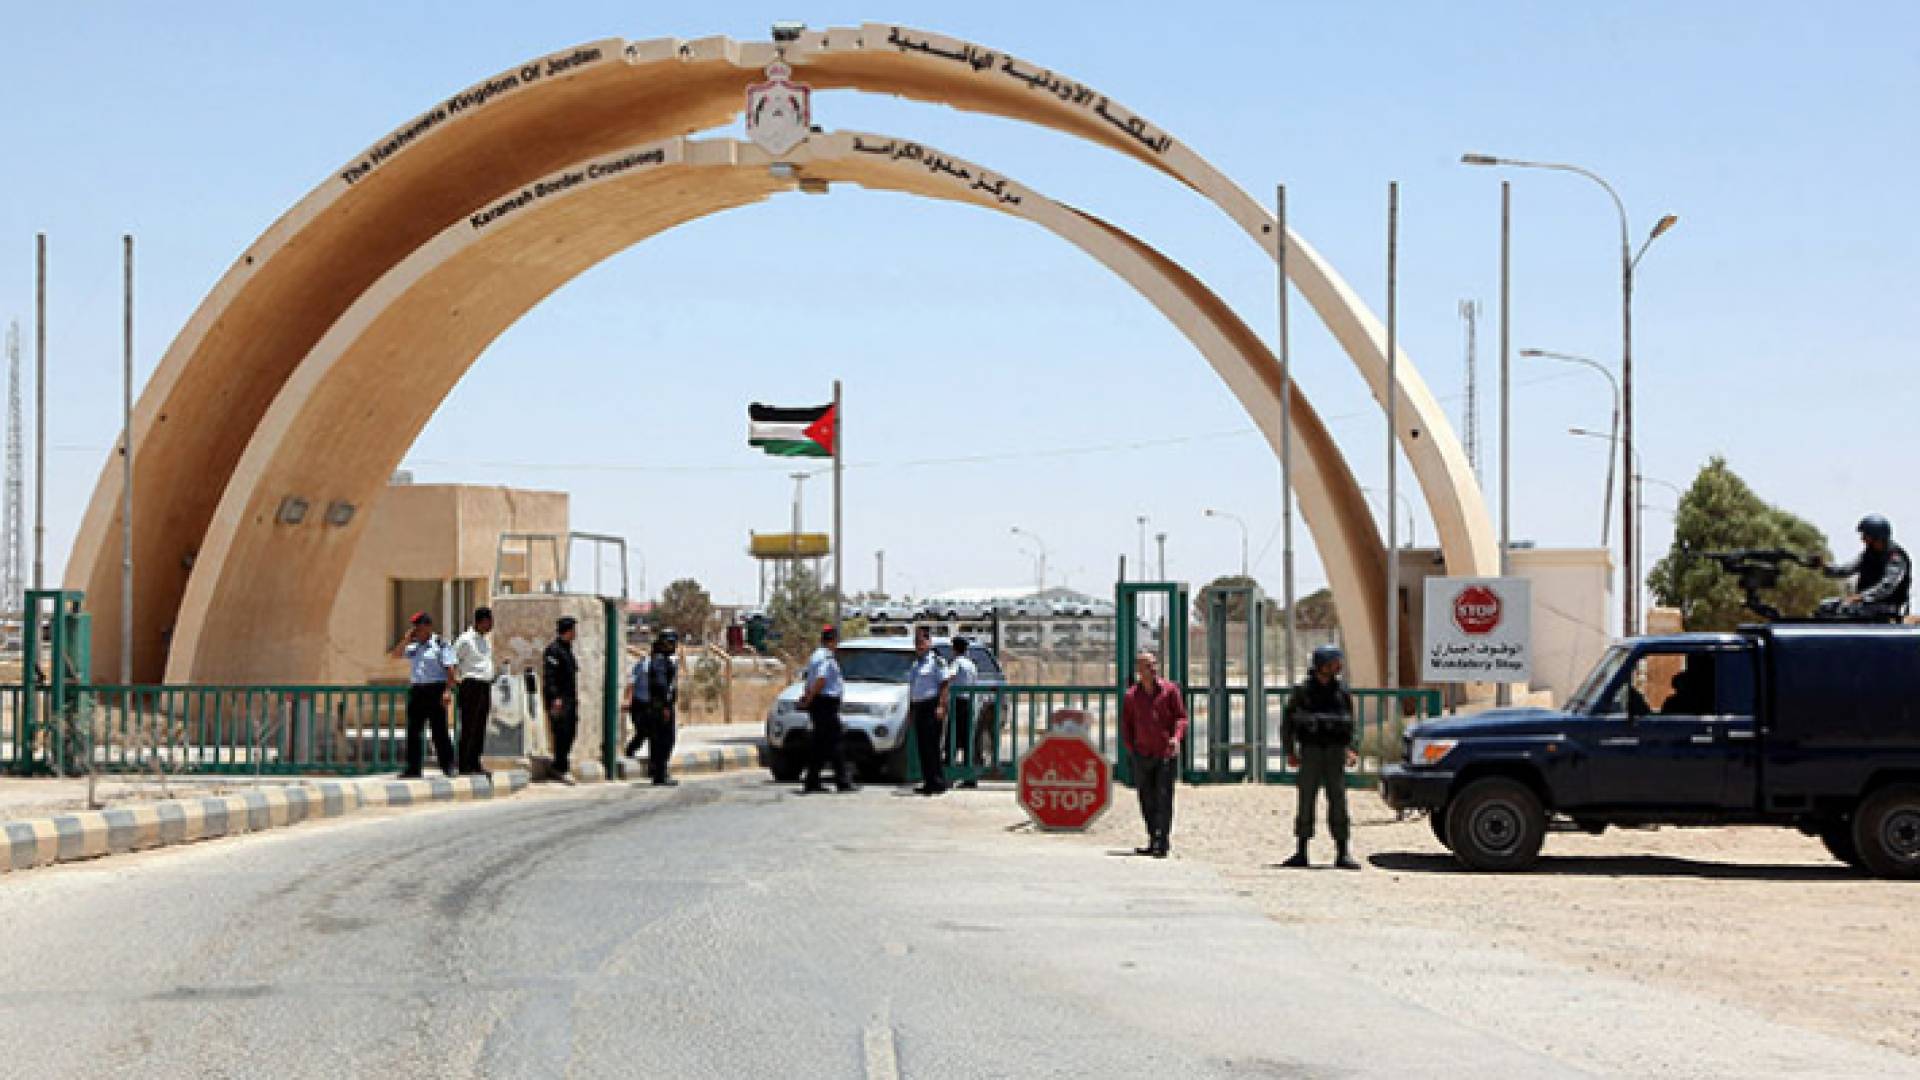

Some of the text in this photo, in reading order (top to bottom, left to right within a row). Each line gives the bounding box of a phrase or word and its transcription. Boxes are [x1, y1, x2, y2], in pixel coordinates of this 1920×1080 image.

[448, 75, 519, 114] Kingdom
[546, 48, 600, 75] Jordan
[534, 171, 585, 198] Border
[1457, 604, 1497, 617] STOP
[1030, 789, 1097, 812] STOP
